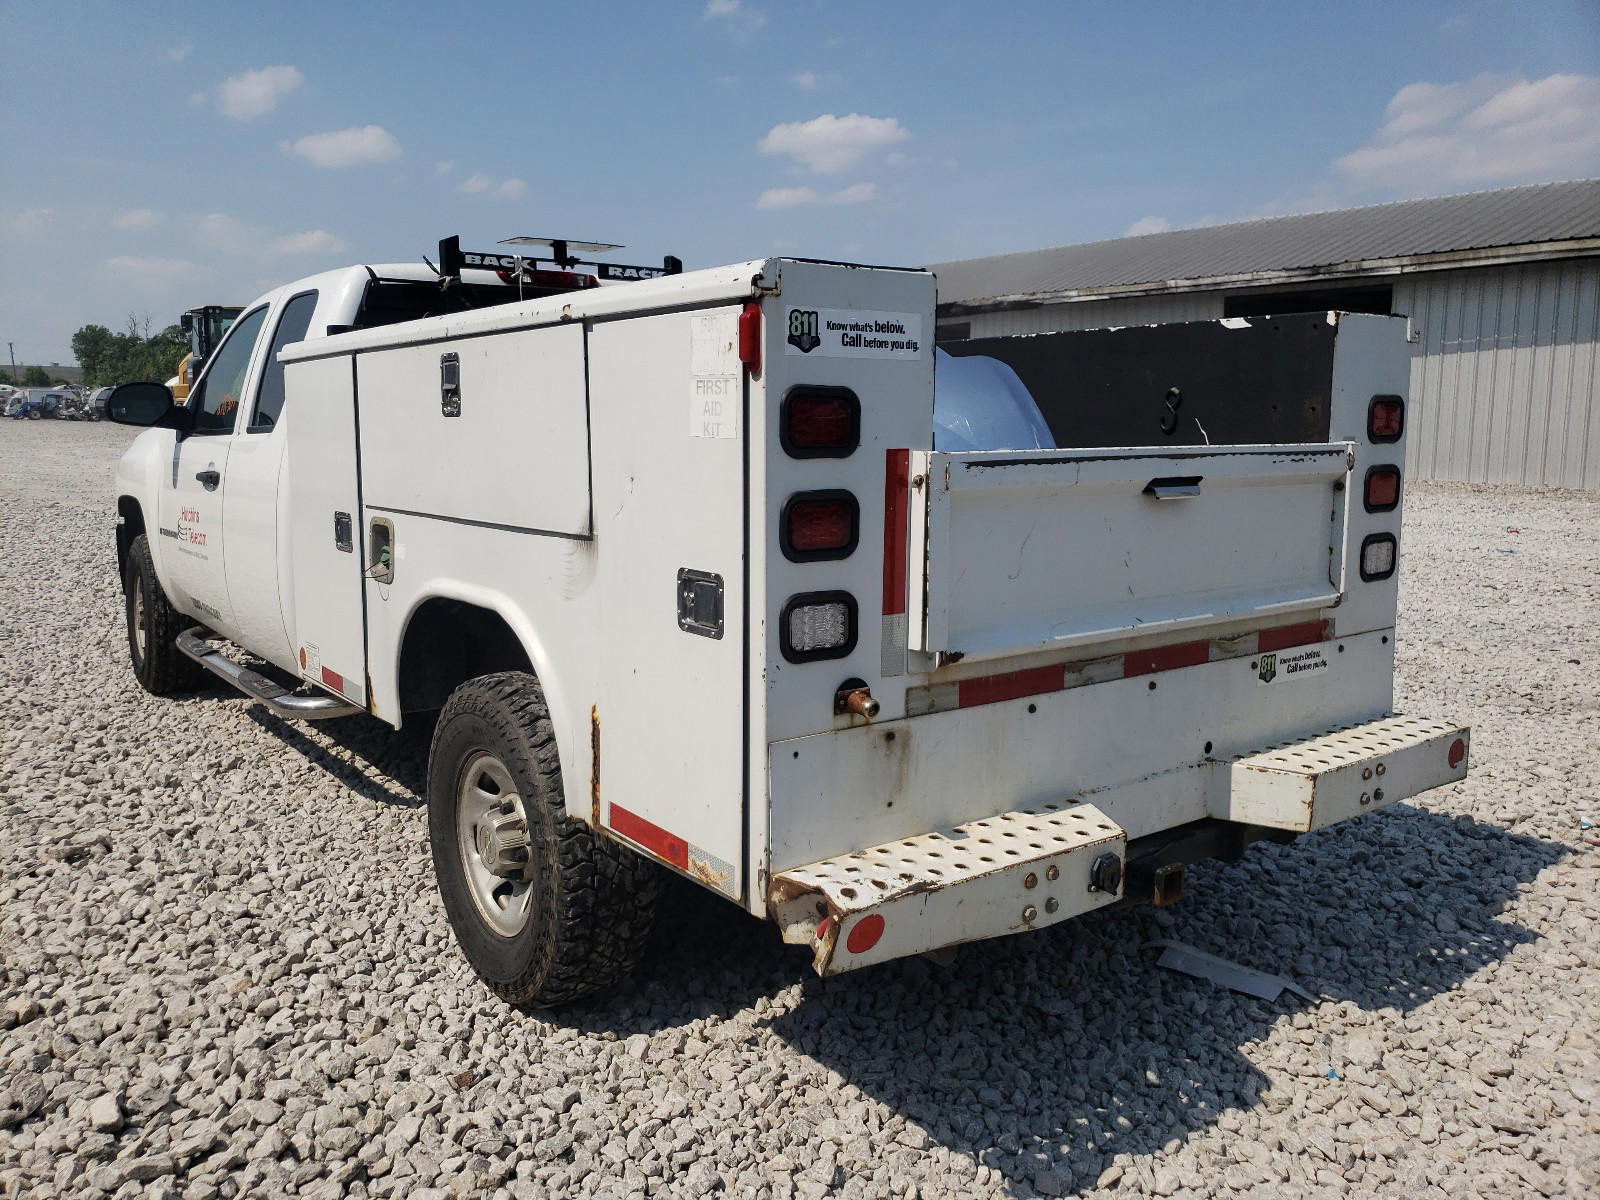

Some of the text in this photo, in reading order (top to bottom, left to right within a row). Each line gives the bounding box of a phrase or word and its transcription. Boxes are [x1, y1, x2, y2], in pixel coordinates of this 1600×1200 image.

[464, 254, 667, 279] BACK RACK
[789, 309, 820, 336] 811
[826, 320, 906, 334] Know what's below.
[841, 333, 920, 352] Call before you dig.
[696, 380, 730, 395] FIRST
[703, 400, 722, 416] AID
[703, 421, 722, 437] KIT
[1260, 654, 1276, 673] 811
[1287, 663, 1298, 674] Call
